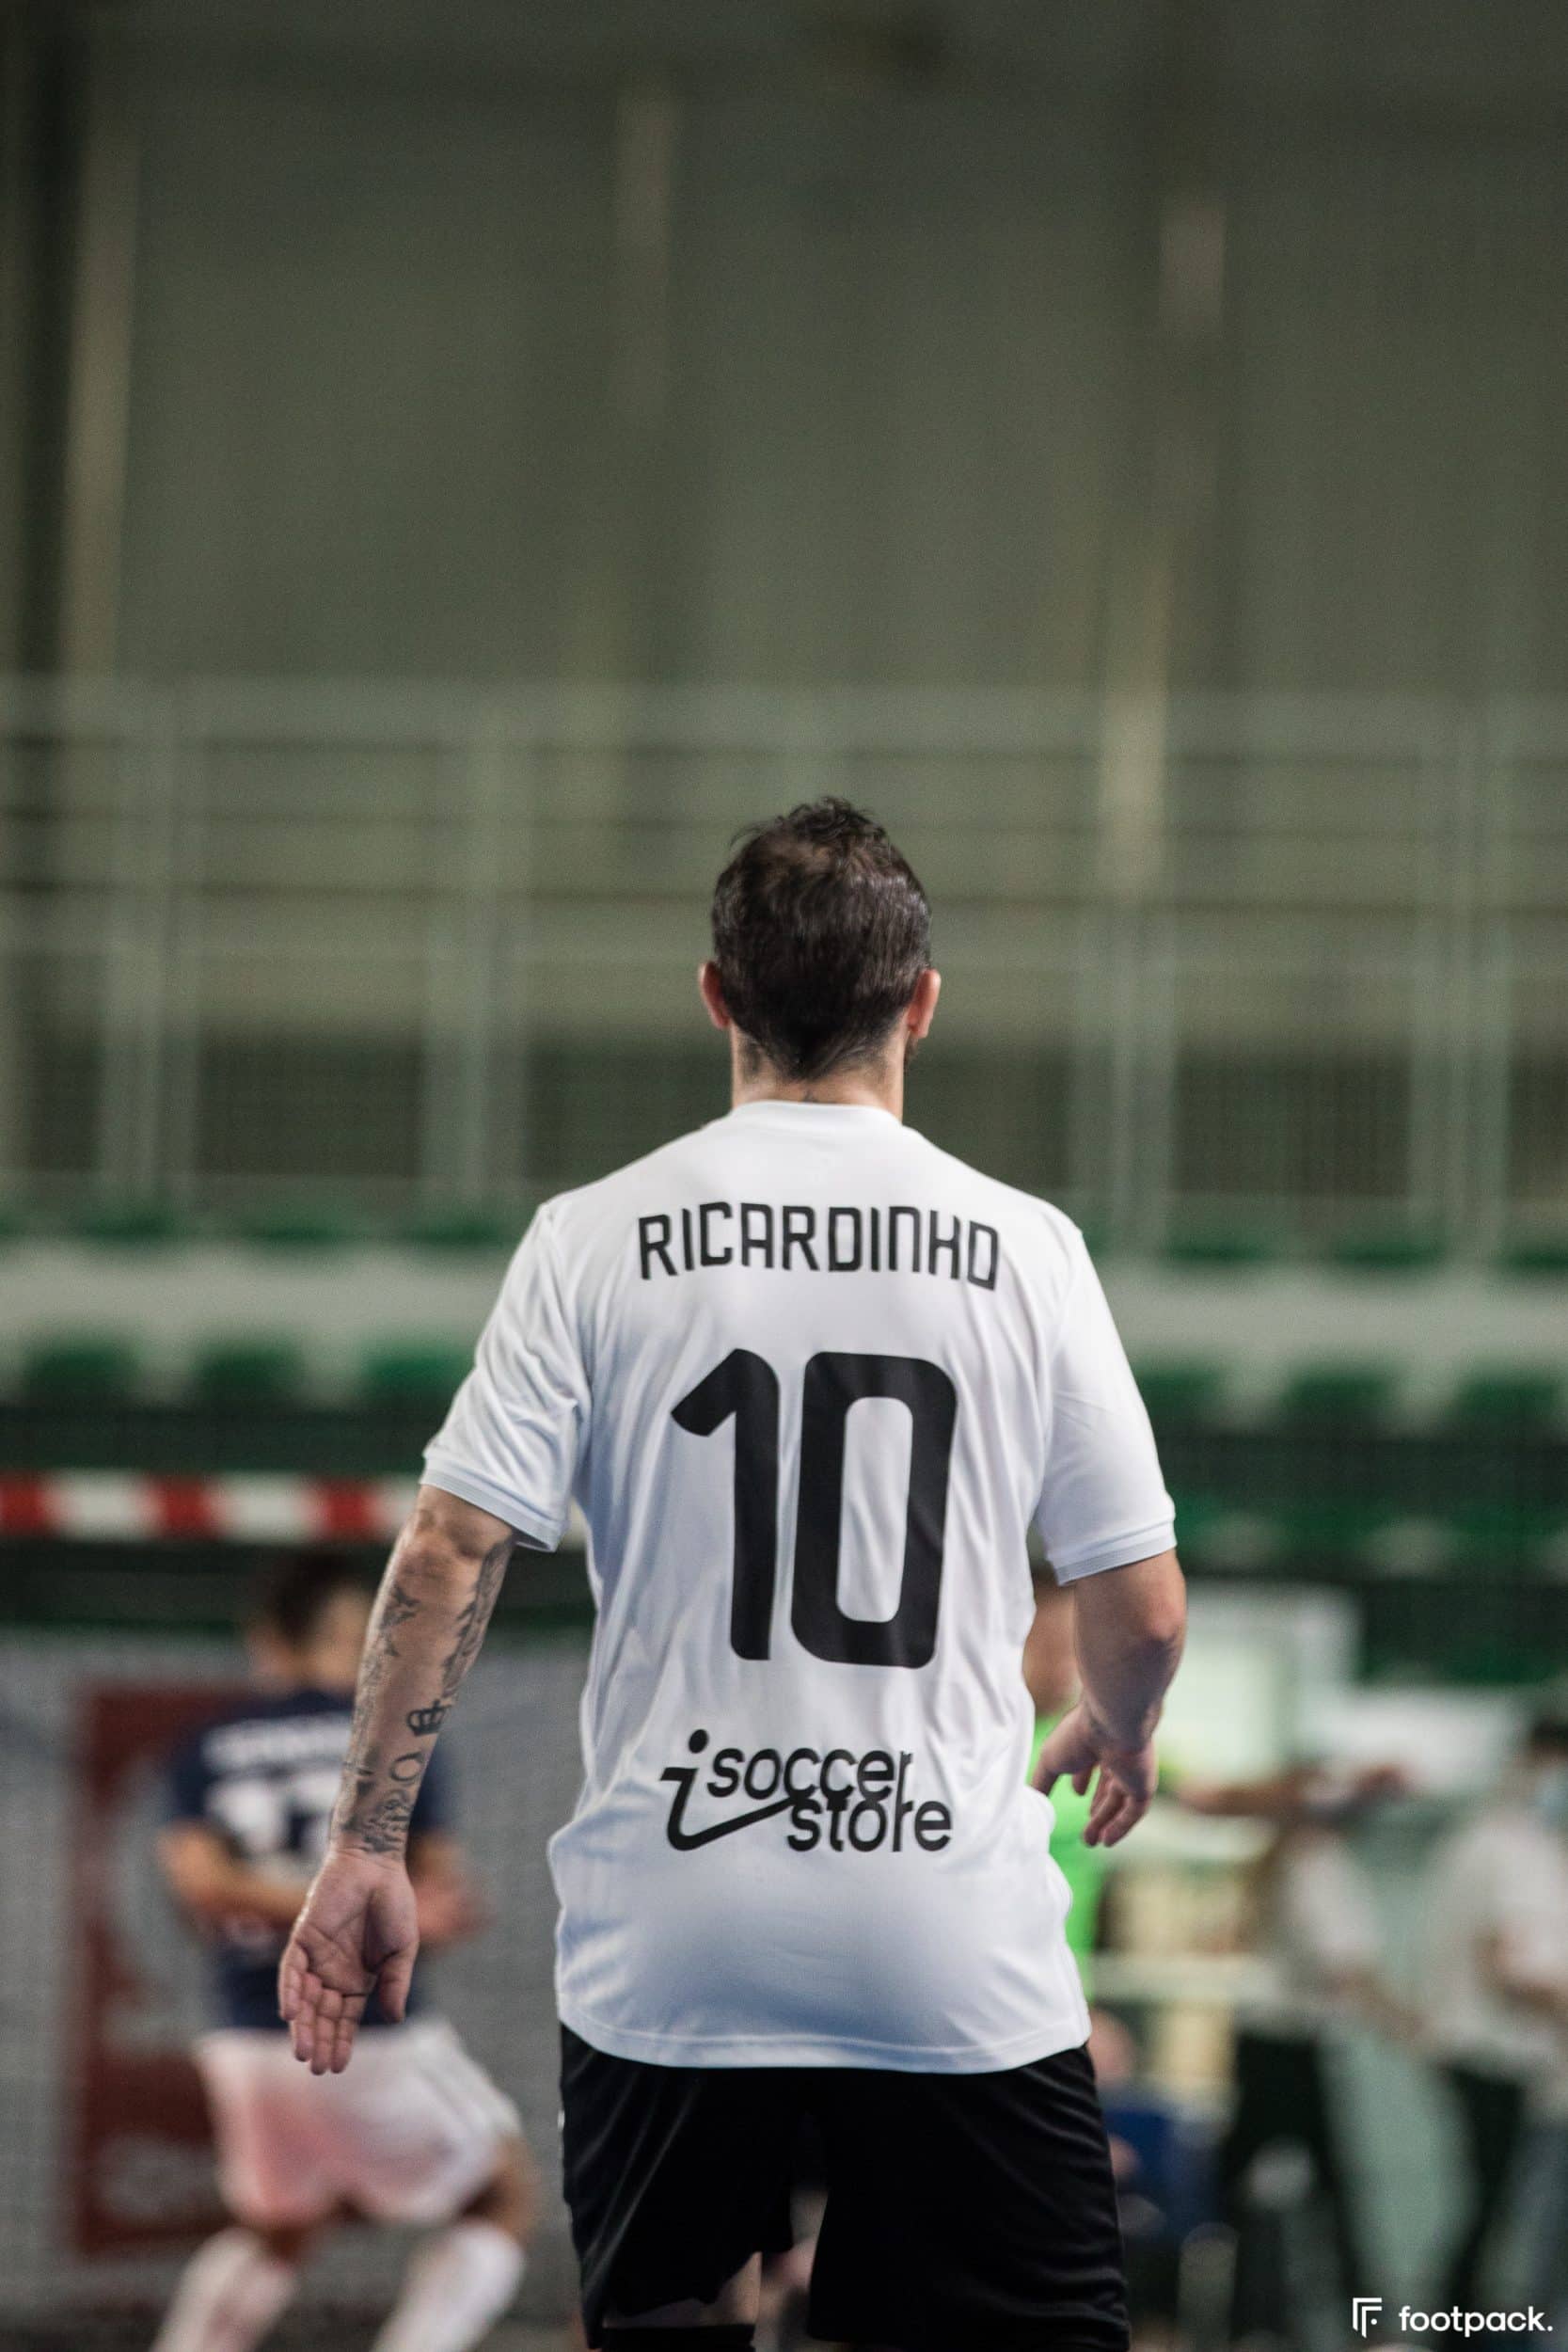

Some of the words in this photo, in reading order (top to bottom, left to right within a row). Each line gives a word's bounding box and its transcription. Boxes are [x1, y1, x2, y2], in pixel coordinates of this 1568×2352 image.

[638, 1200, 999, 1291] RICARDINHO
[670, 1347, 958, 1670] 10
[786, 1795, 953, 1853] store
